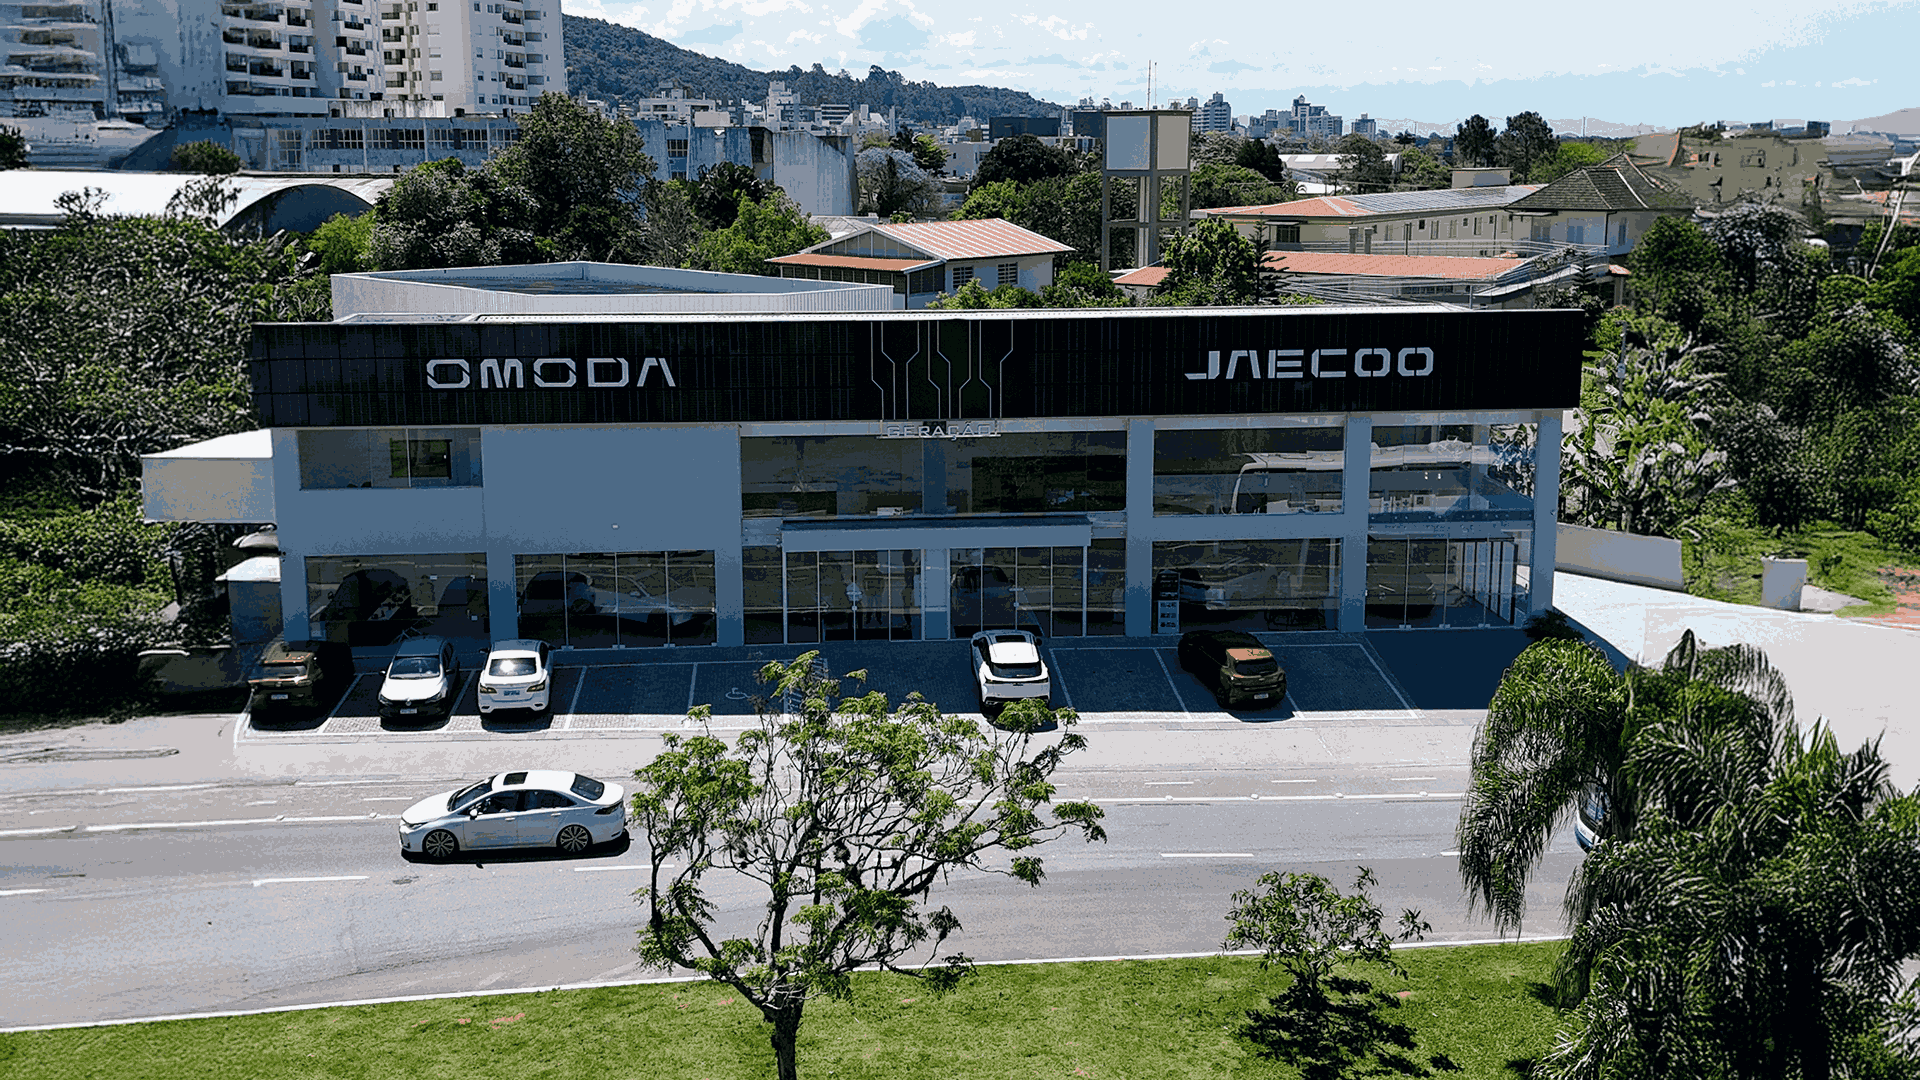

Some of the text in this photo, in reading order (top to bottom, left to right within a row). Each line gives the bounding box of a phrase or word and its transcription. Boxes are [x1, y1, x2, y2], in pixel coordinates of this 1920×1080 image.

[426, 357, 676, 389] OMODA
[1184, 347, 1434, 380] JAECOO
[887, 421, 991, 441] GERAÇÃO
